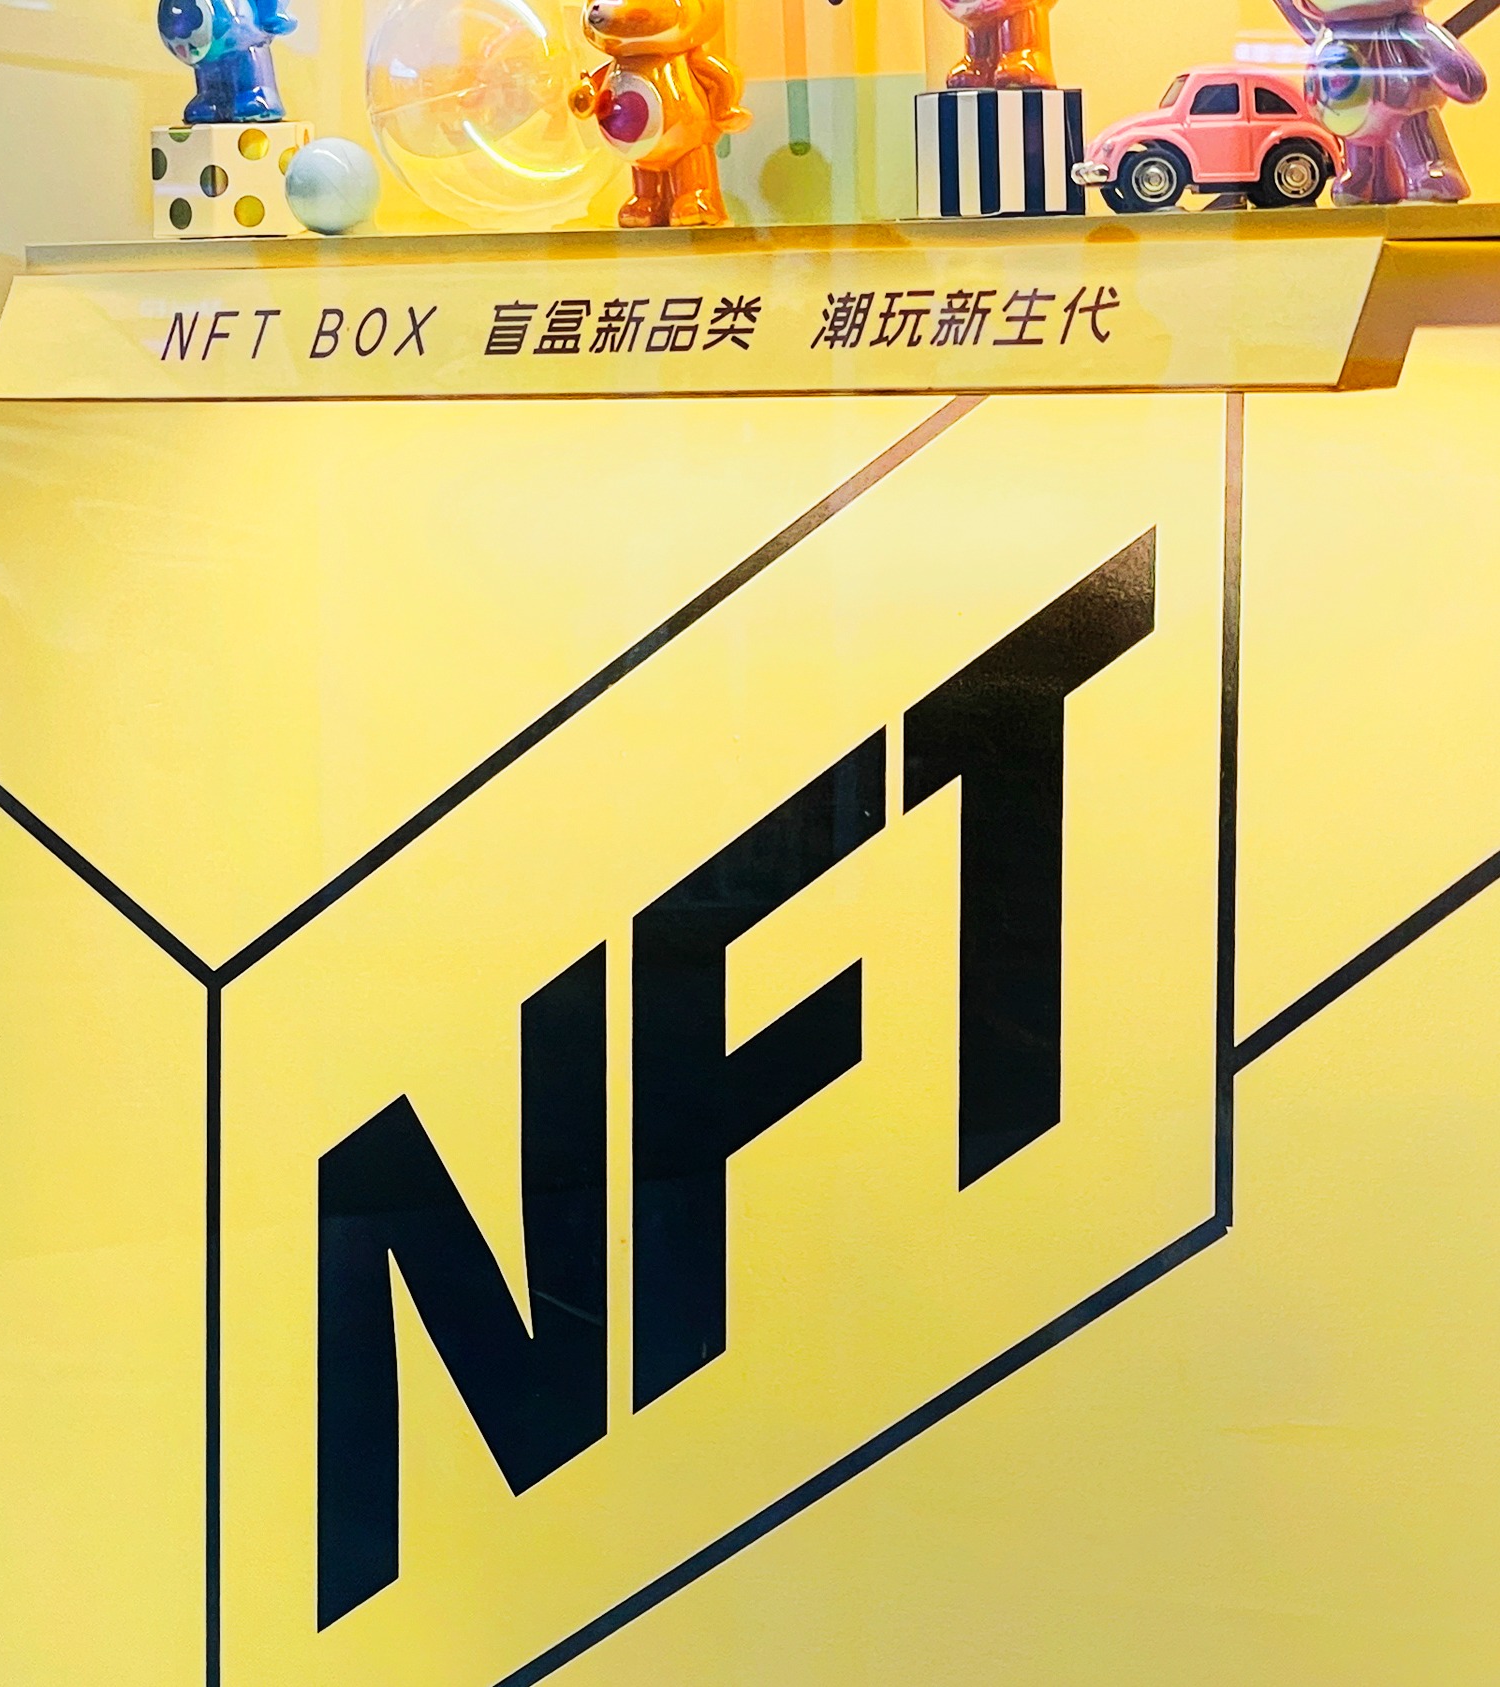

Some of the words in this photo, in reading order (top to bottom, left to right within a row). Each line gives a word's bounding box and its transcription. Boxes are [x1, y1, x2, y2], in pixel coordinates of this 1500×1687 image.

[161, 309, 281, 361] NFT
[309, 306, 438, 359] BOX
[484, 295, 762, 355] 盲盒新品类
[810, 286, 1121, 349] 潮玩新生代
[316, 524, 1157, 1634] NFT
